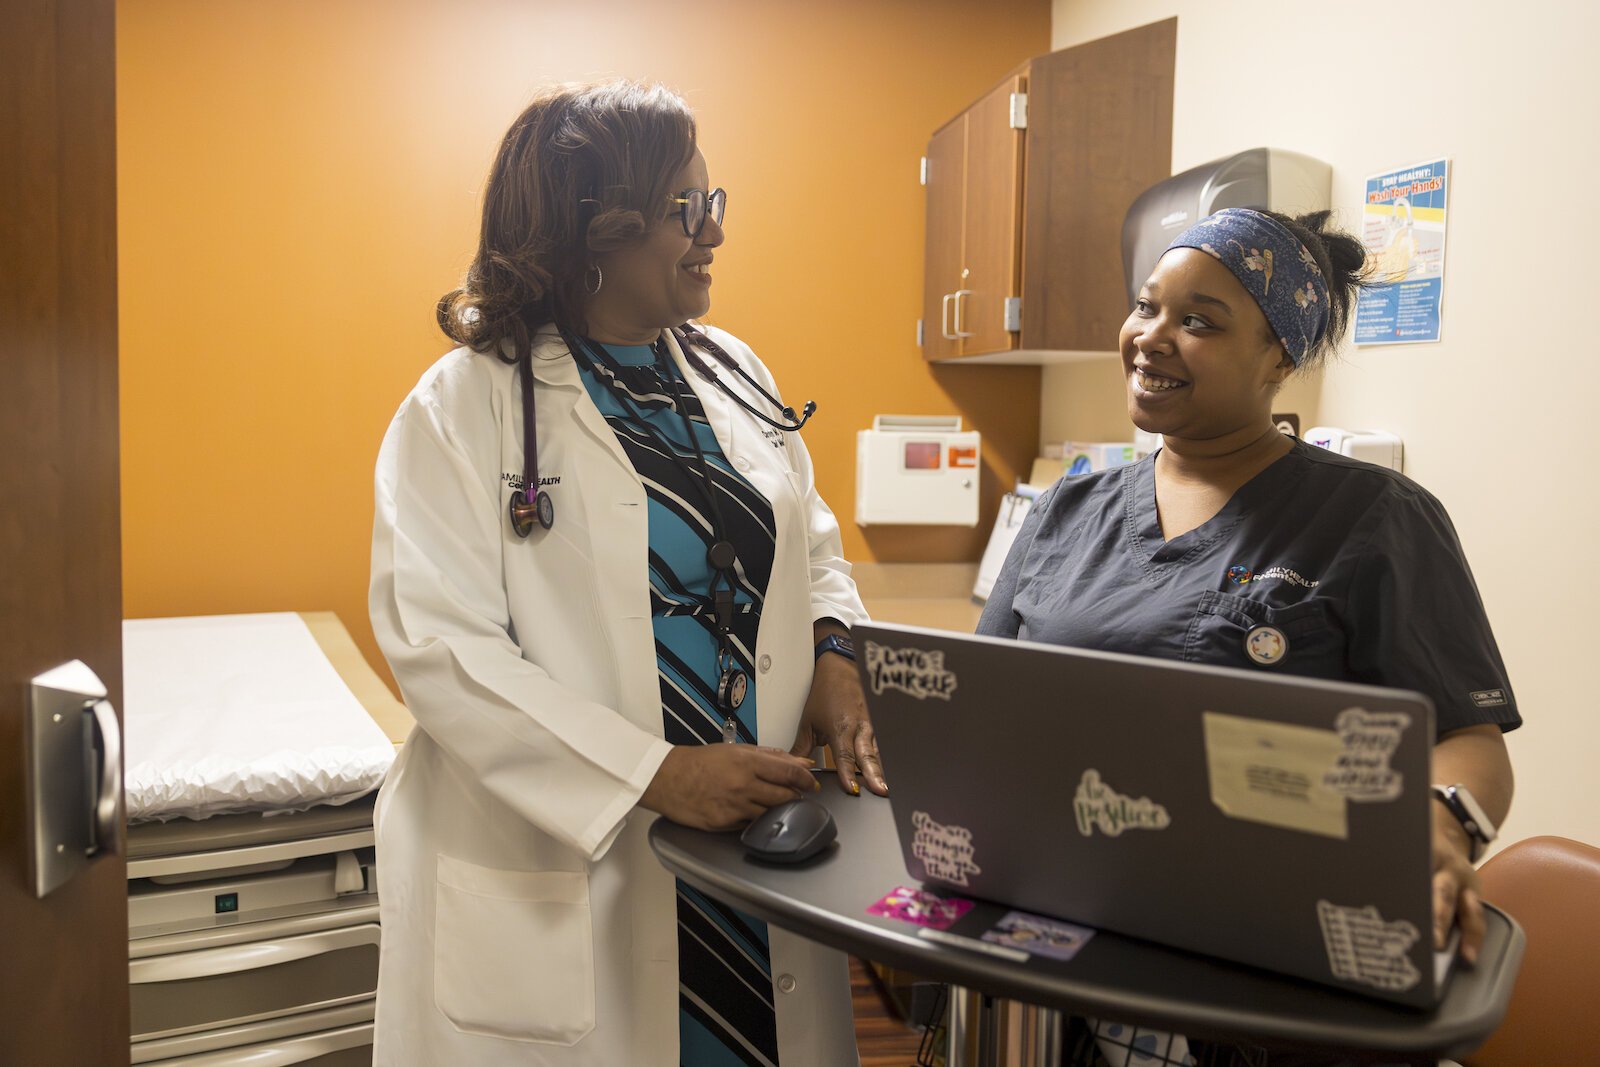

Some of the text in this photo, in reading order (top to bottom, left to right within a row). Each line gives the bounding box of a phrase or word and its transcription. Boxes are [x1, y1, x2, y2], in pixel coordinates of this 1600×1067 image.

[1368, 176, 1443, 203] Wash Your Hands!
